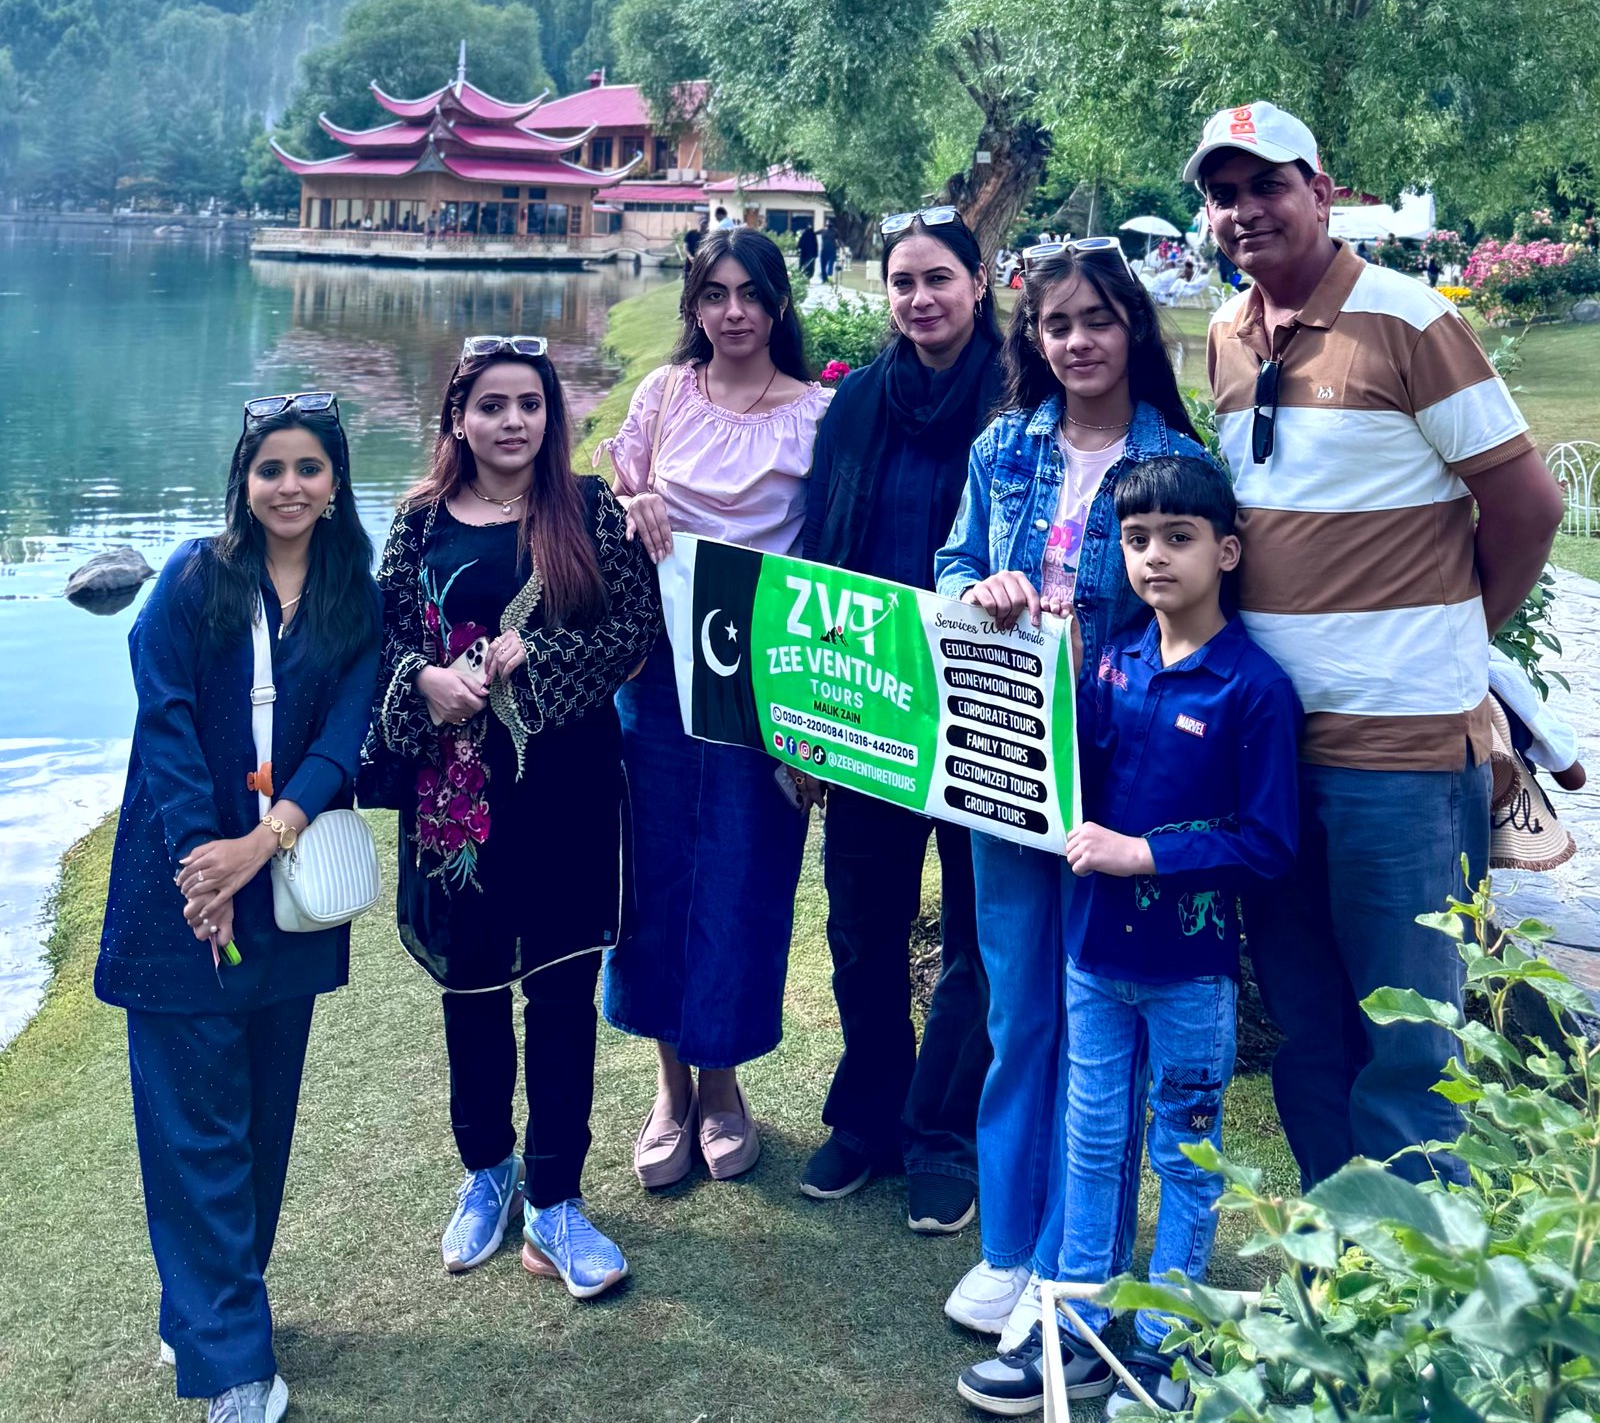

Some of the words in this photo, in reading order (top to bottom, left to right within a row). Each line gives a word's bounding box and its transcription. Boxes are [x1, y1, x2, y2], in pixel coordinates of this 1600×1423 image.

[786, 575, 883, 656] ZVT
[935, 612, 979, 634] Services
[1009, 622, 1045, 646] Provide
[945, 642, 1010, 666] EDUCATIONAL
[1011, 653, 1038, 674] TOURS
[766, 645, 804, 675] ZEE
[806, 646, 914, 712] VENTURE
[810, 679, 864, 709] TOURS
[950, 671, 1010, 696] HONEYMOON
[1010, 683, 1038, 704] TOURS
[813, 700, 839, 717] MALIK
[840, 708, 861, 724] ZAIN
[957, 700, 1008, 726] CORPORATE
[1008, 714, 1037, 735] TOURS
[1176, 714, 1205, 736] MARVEL
[783, 710, 844, 739] 0300-2200084
[848, 731, 915, 760] 0316-4420206
[966, 732, 999, 754] FAMILY
[1000, 741, 1029, 763] TOURS
[828, 753, 916, 792] @ZEEVENTURETOURS
[953, 760, 1008, 789] CUSTOMIZED
[1009, 776, 1039, 798] TOURS
[964, 794, 995, 816] GROUP
[996, 804, 1027, 826] TOURS
